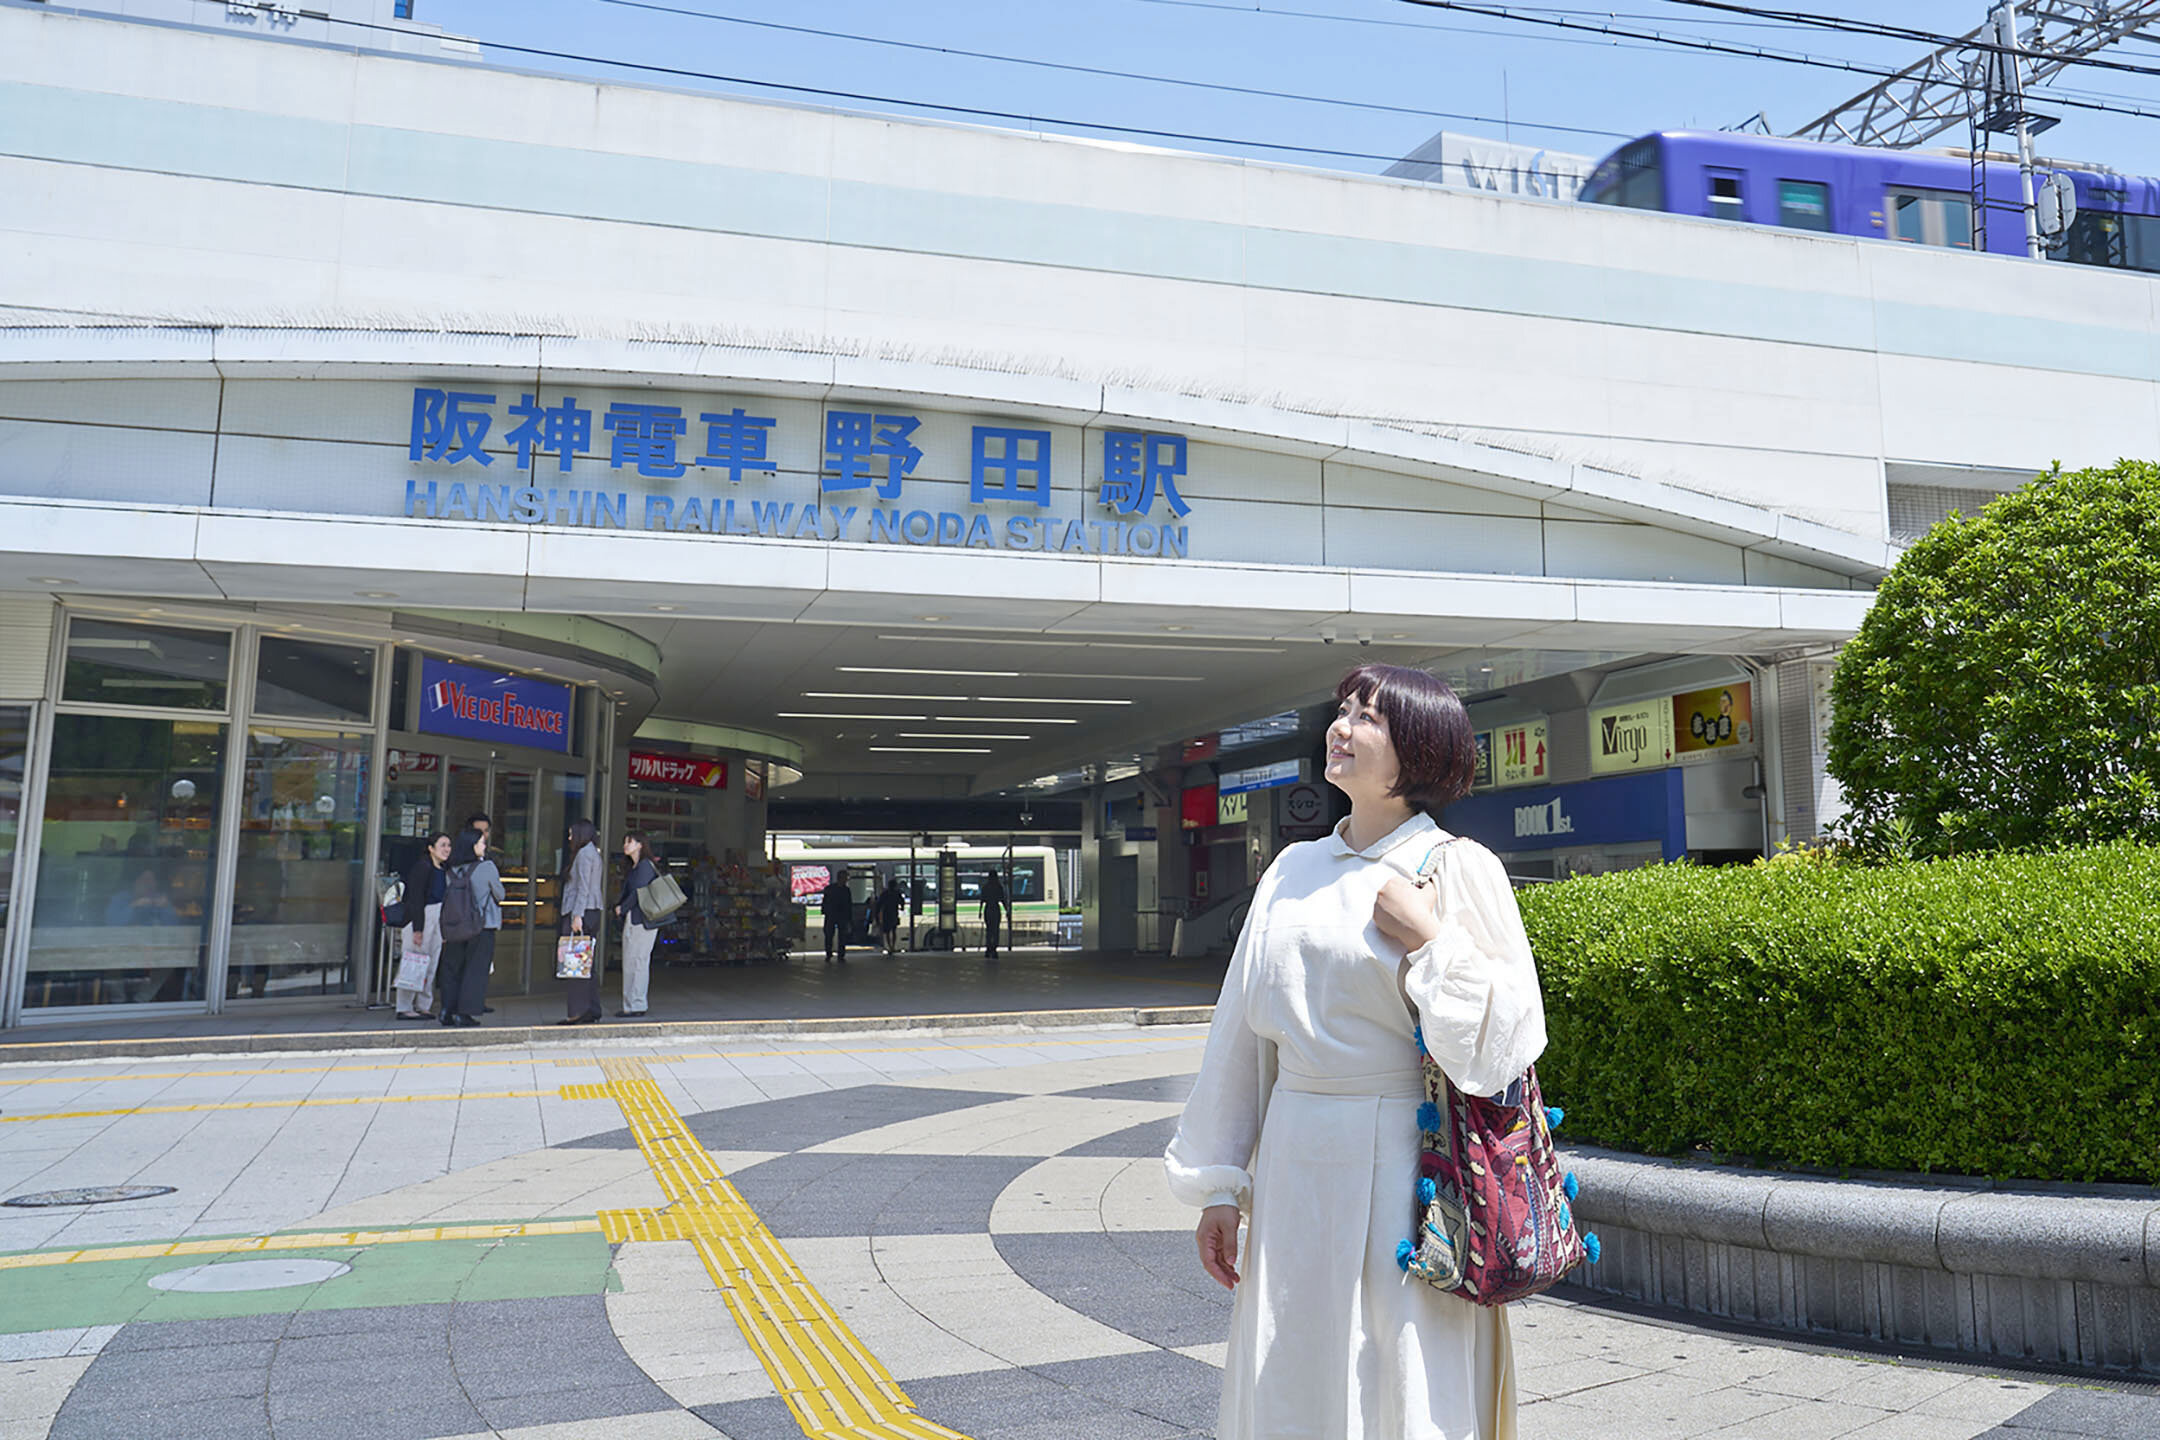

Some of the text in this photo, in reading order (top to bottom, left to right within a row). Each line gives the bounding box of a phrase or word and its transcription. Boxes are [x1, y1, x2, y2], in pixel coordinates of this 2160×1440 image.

[409, 387, 1192, 518] 阪神電車 野田駅
[404, 480, 1189, 558] HANSHIN RAILWAY NODA STATION
[631, 757, 696, 780] ツルハドラッグ
[1602, 716, 1647, 763] Virgo
